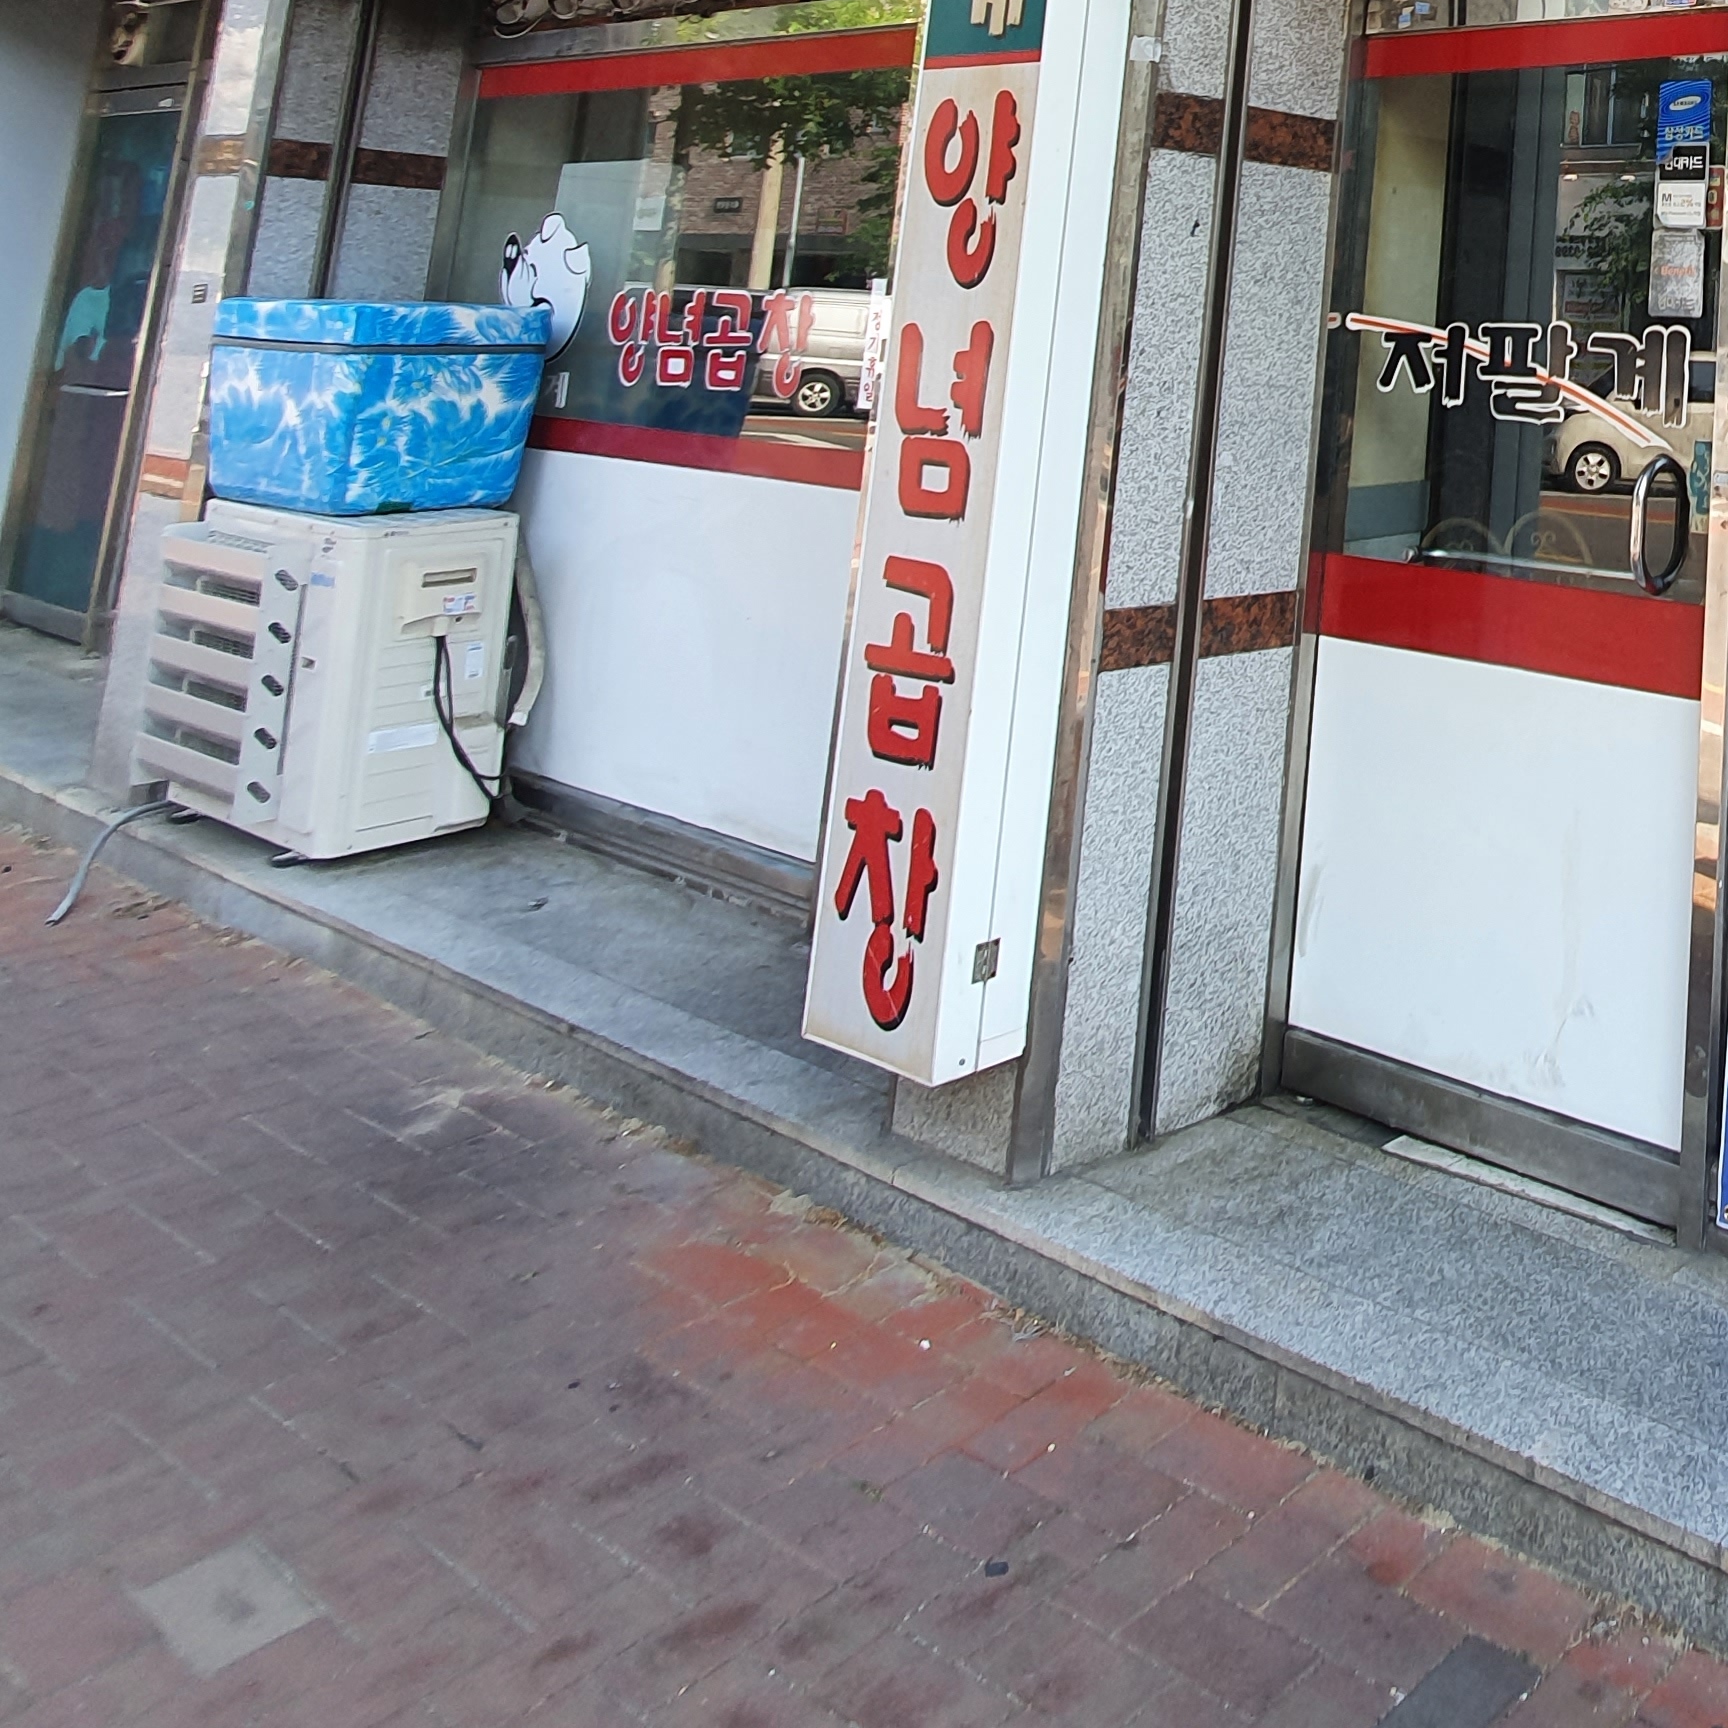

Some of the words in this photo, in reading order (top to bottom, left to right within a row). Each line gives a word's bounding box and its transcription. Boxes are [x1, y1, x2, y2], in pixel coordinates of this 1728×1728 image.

[609, 287, 816, 399] 양념곱창
[1378, 322, 1692, 428] 저팔계
[833, 89, 1020, 1032] 양념곱창
